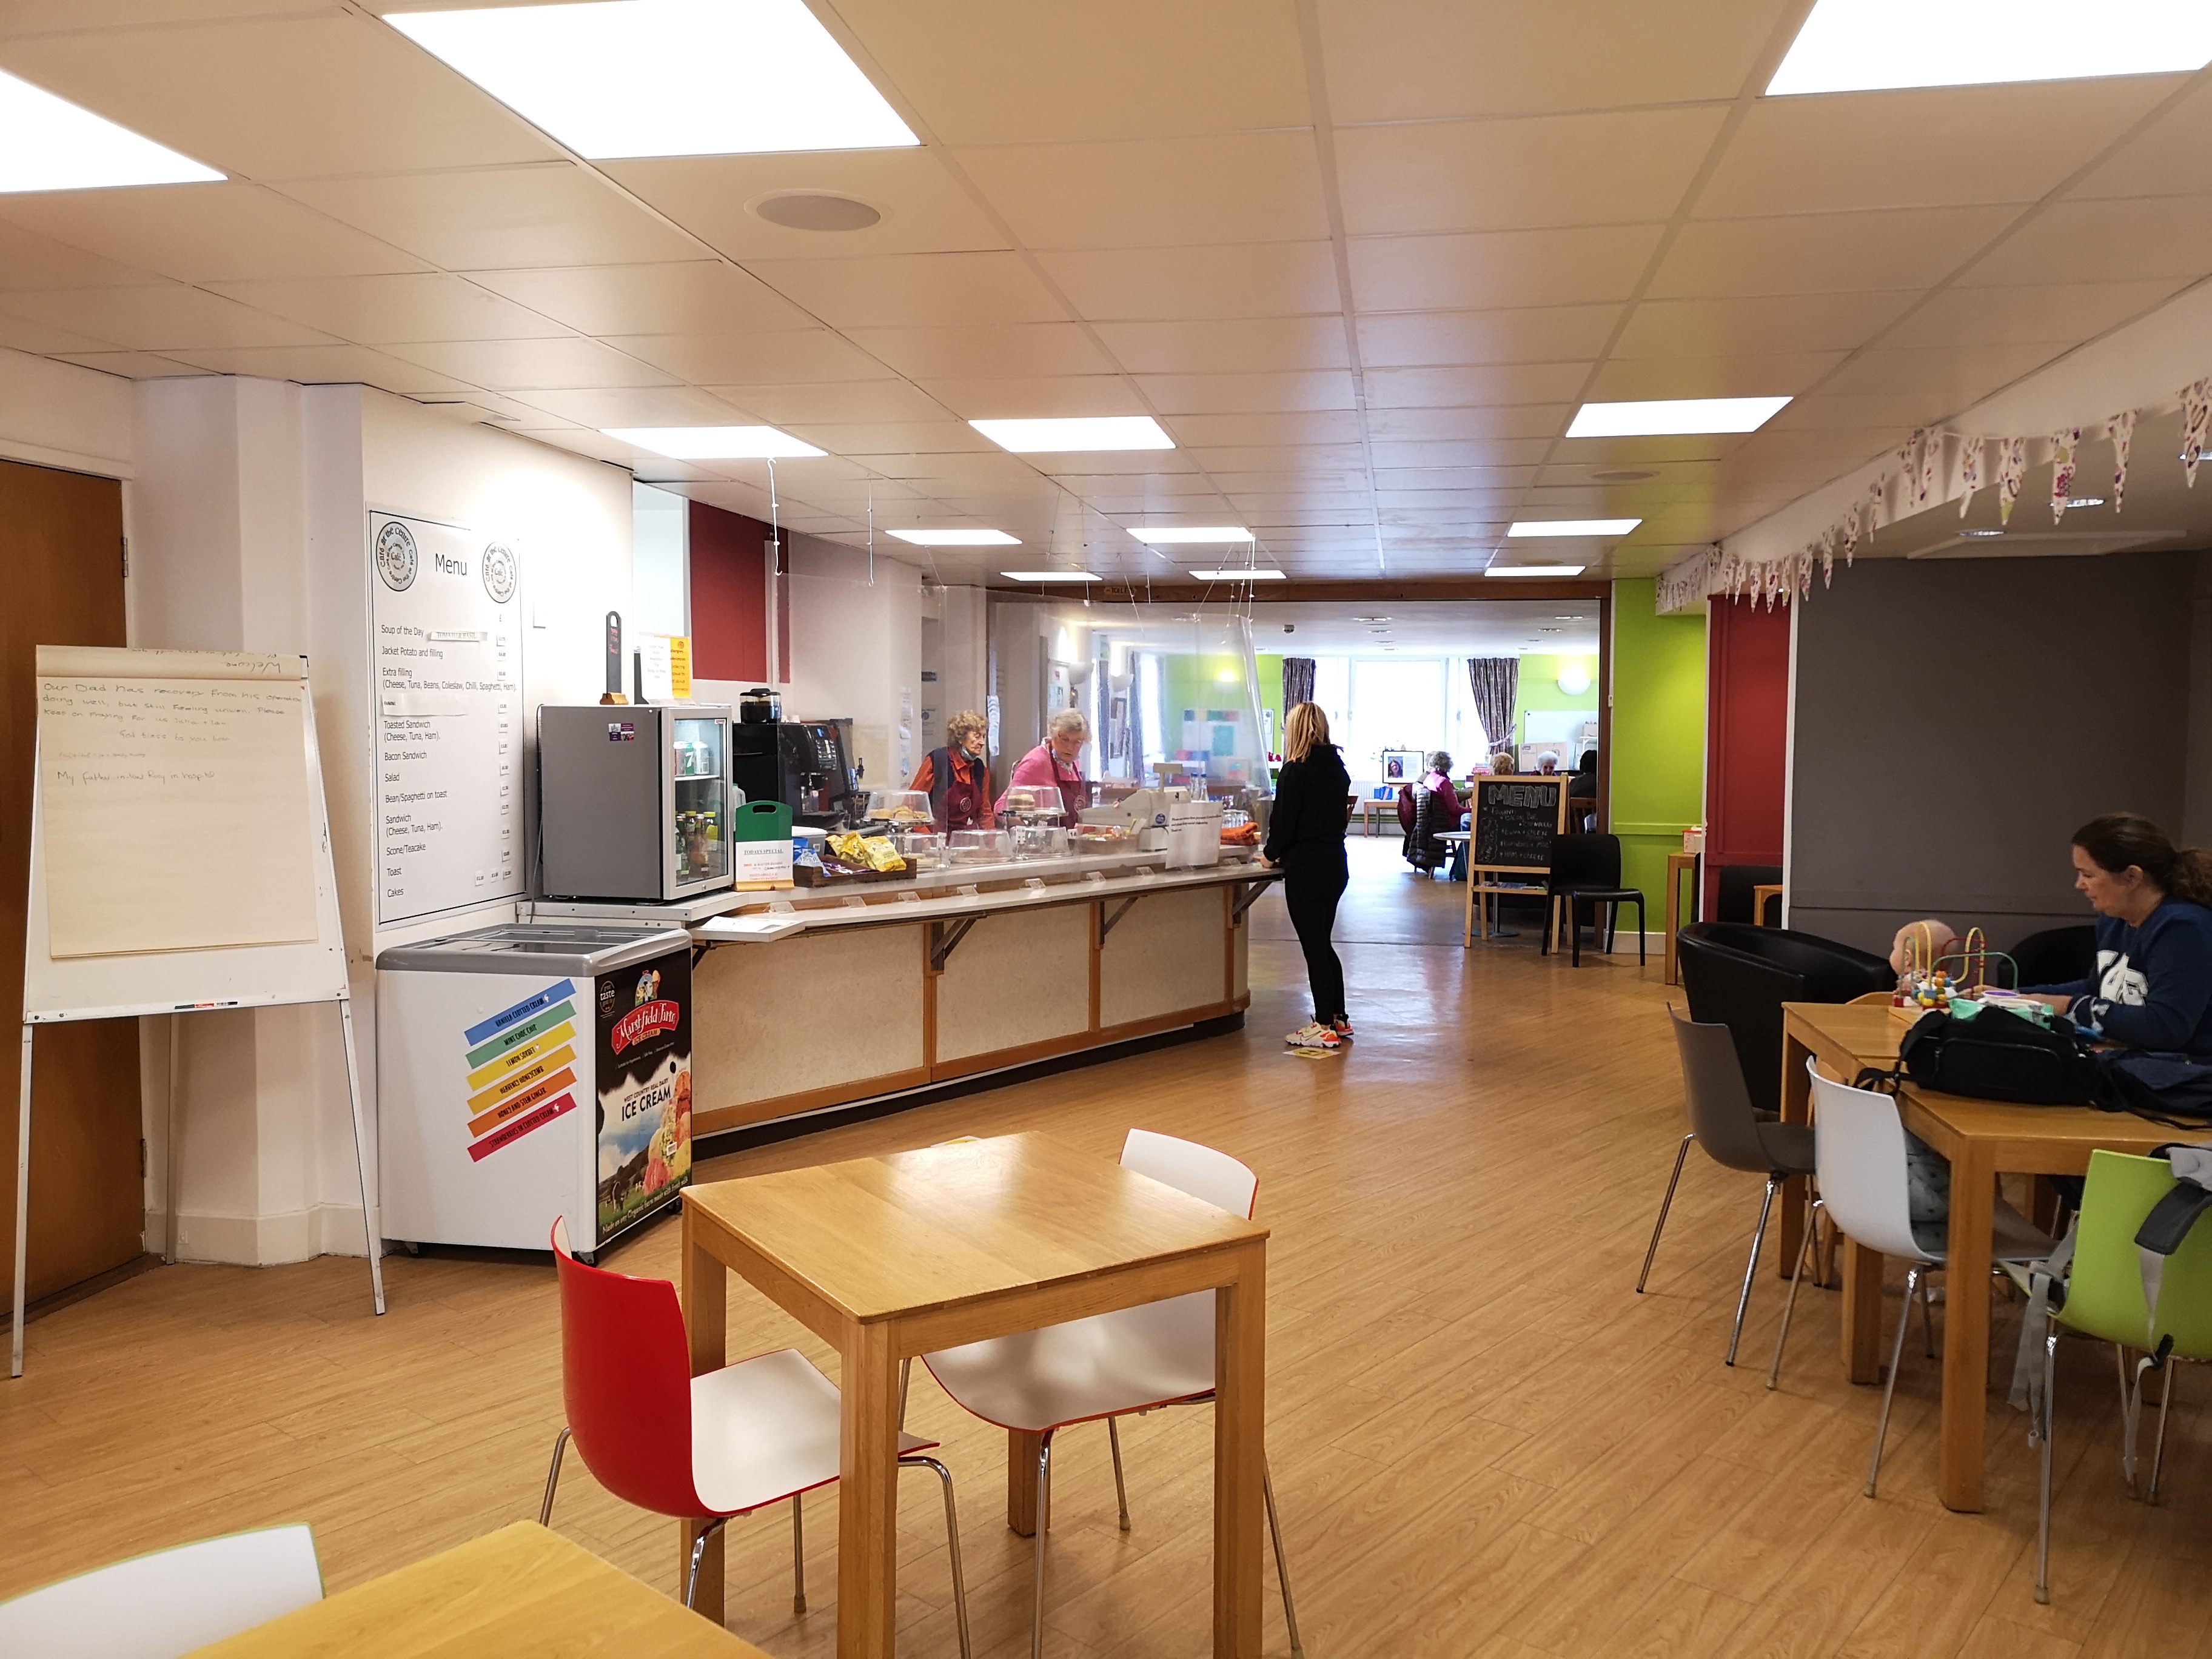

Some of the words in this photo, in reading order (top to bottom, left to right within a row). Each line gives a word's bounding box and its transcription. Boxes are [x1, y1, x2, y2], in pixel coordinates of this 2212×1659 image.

[435, 553, 467, 576] Menu
[381, 625, 395, 636] Soup
[397, 626, 403, 634] of
[403, 626, 412, 635] the
[414, 628, 424, 638] Day
[382, 646, 399, 655] Jacket
[400, 647, 417, 656] Potato
[429, 649, 443, 660] filling
[383, 668, 397, 676] Extra
[398, 668, 412, 679] filling
[383, 680, 406, 690] (Cheese,
[407, 680, 422, 690] Tuna,
[423, 681, 441, 691] Beans,
[442, 682, 464, 691] Coleslaw,
[466, 682, 478, 691] Chilli,
[480, 682, 502, 692] Spaghetti,
[503, 683, 517, 692] Ham).
[43, 694, 73, 705] doing
[384, 720, 405, 729] Toasted
[406, 720, 431, 729] Sandwich
[384, 732, 407, 743] (Cheese,
[409, 732, 423, 741] Tuna,
[424, 731, 441, 742] Ham).
[384, 752, 401, 761] Bacon
[402, 751, 427, 760] Sandwich
[57, 771, 74, 786] My
[385, 773, 400, 782] Salad
[385, 792, 426, 803] Bean/Spaghetti
[435, 790, 447, 799] toast
[1488, 785, 1557, 809] MENU
[386, 814, 412, 824] Sandwich
[386, 826, 410, 838] (Cheese,
[411, 824, 426, 834] Tuna,
[427, 822, 443, 832] Ham).
[386, 843, 426, 856] Scone/Teacake
[386, 867, 401, 877] Toast
[387, 888, 404, 897] Cakes
[600, 990, 615, 1001] taste
[495, 1013, 514, 1027] VANILLA
[512, 1005, 531, 1019] CLOTTED
[529, 997, 545, 1012] CREAM
[504, 1037, 516, 1047] MINT
[516, 1031, 528, 1041] CHOC
[526, 1024, 538, 1034] CHIP
[634, 1034, 642, 1044] ICE
[642, 1030, 658, 1039] CREAM
[506, 1055, 521, 1067] LEMON
[520, 1046, 536, 1061] SORBET
[500, 1080, 520, 1094] HEAVENLY
[518, 1065, 545, 1084] HONEYCOMB
[624, 1094, 634, 1102] WEST
[634, 1087, 650, 1099] COUNTRY
[659, 1078, 669, 1087] DAIRY
[497, 1107, 512, 1119] HONEY
[511, 1101, 521, 1112] AND
[520, 1096, 532, 1107] STEM
[531, 1087, 547, 1102] GINGER
[622, 1100, 637, 1122] ICE
[640, 1084, 671, 1112] CREAM
[489, 1128, 520, 1147] STRAWBERRIES
[518, 1123, 525, 1131] IN
[523, 1114, 541, 1130] CLOTTED
[540, 1107, 555, 1121] CREAM
